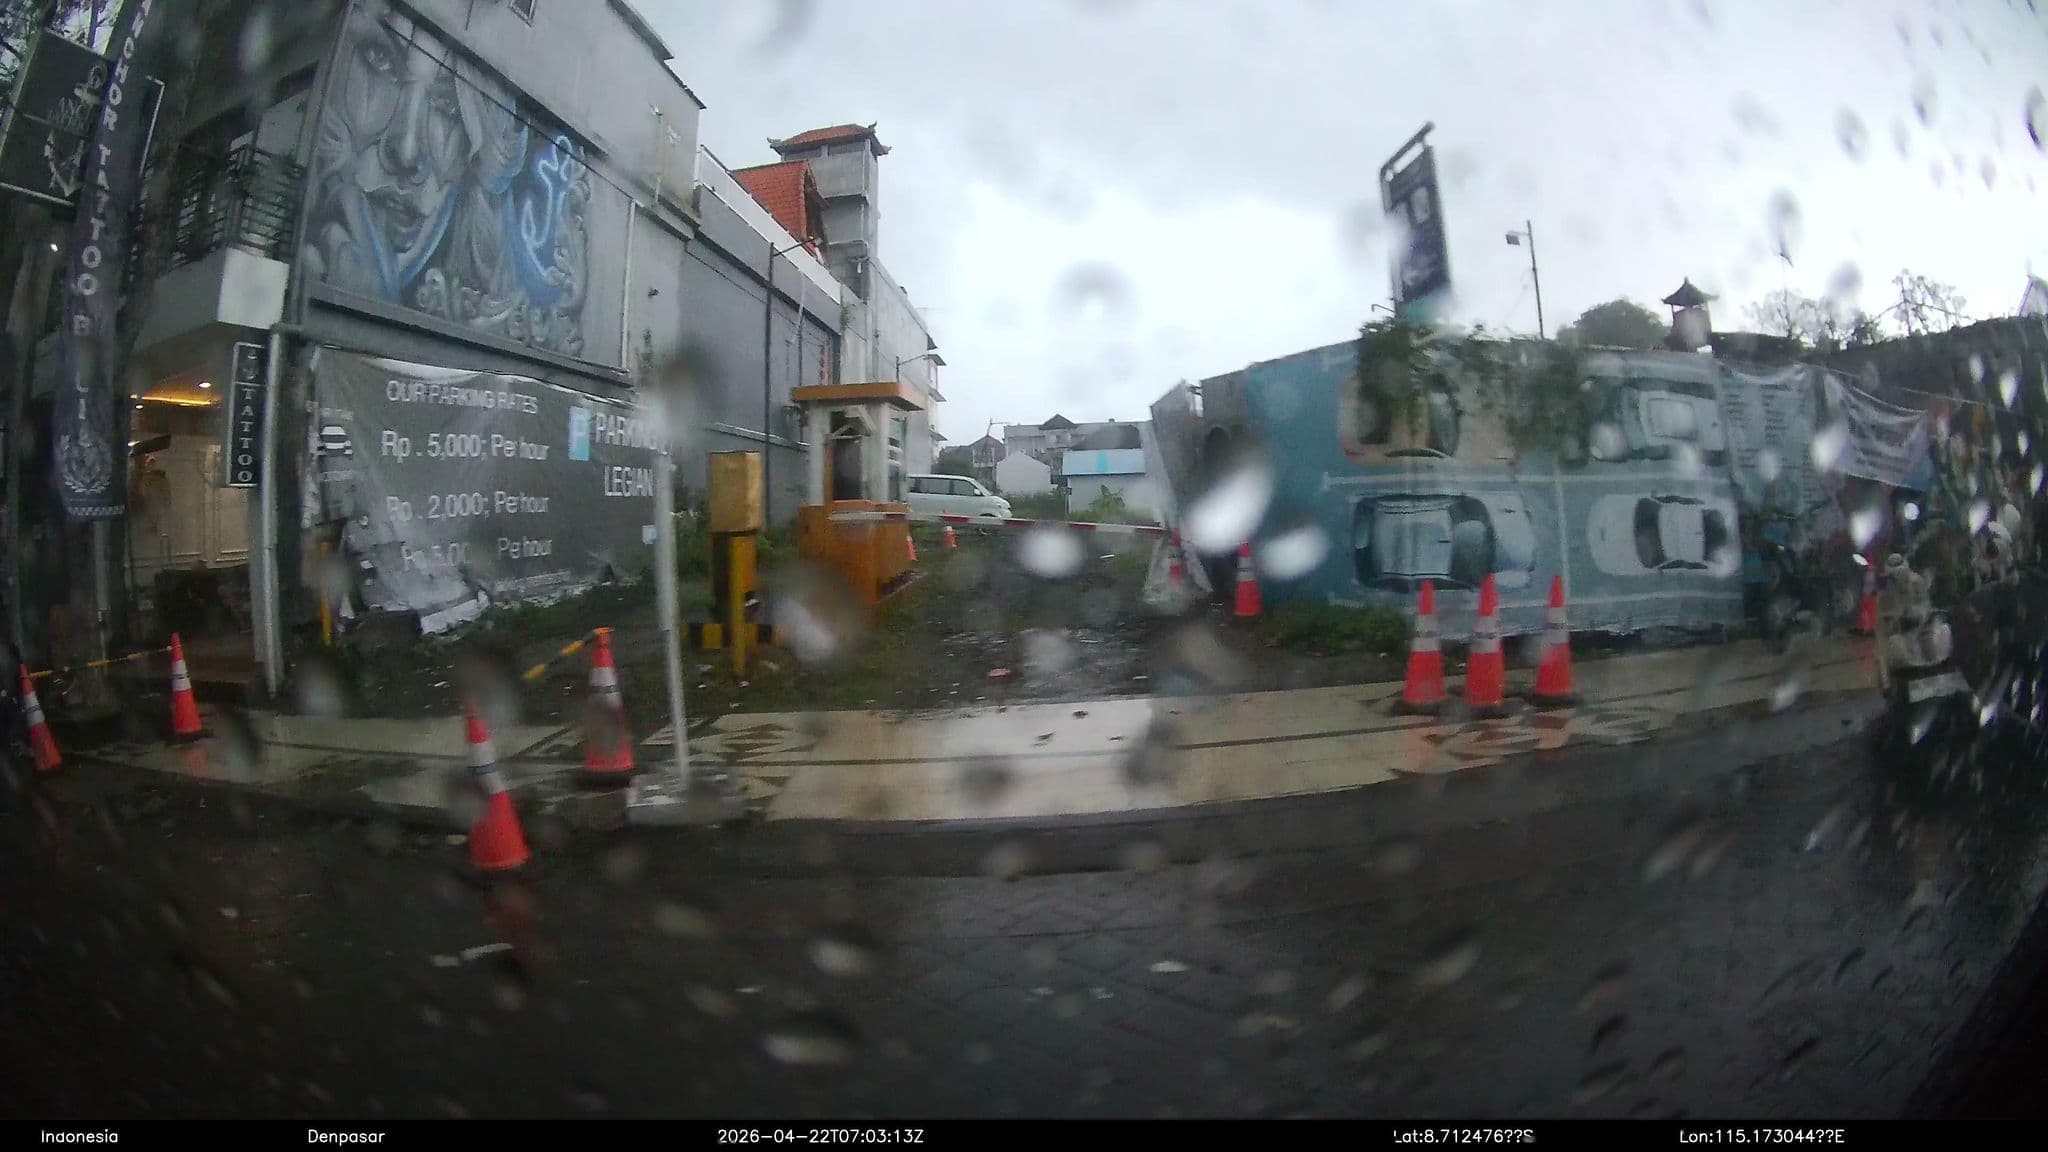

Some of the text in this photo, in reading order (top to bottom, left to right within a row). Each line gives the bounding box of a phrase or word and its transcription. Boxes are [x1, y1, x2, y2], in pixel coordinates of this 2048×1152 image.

[77, 144, 111, 296] TATTOO
[386, 380, 425, 402] OUR
[237, 388, 257, 482] TATTOO
[604, 465, 654, 498] LEGIAN
